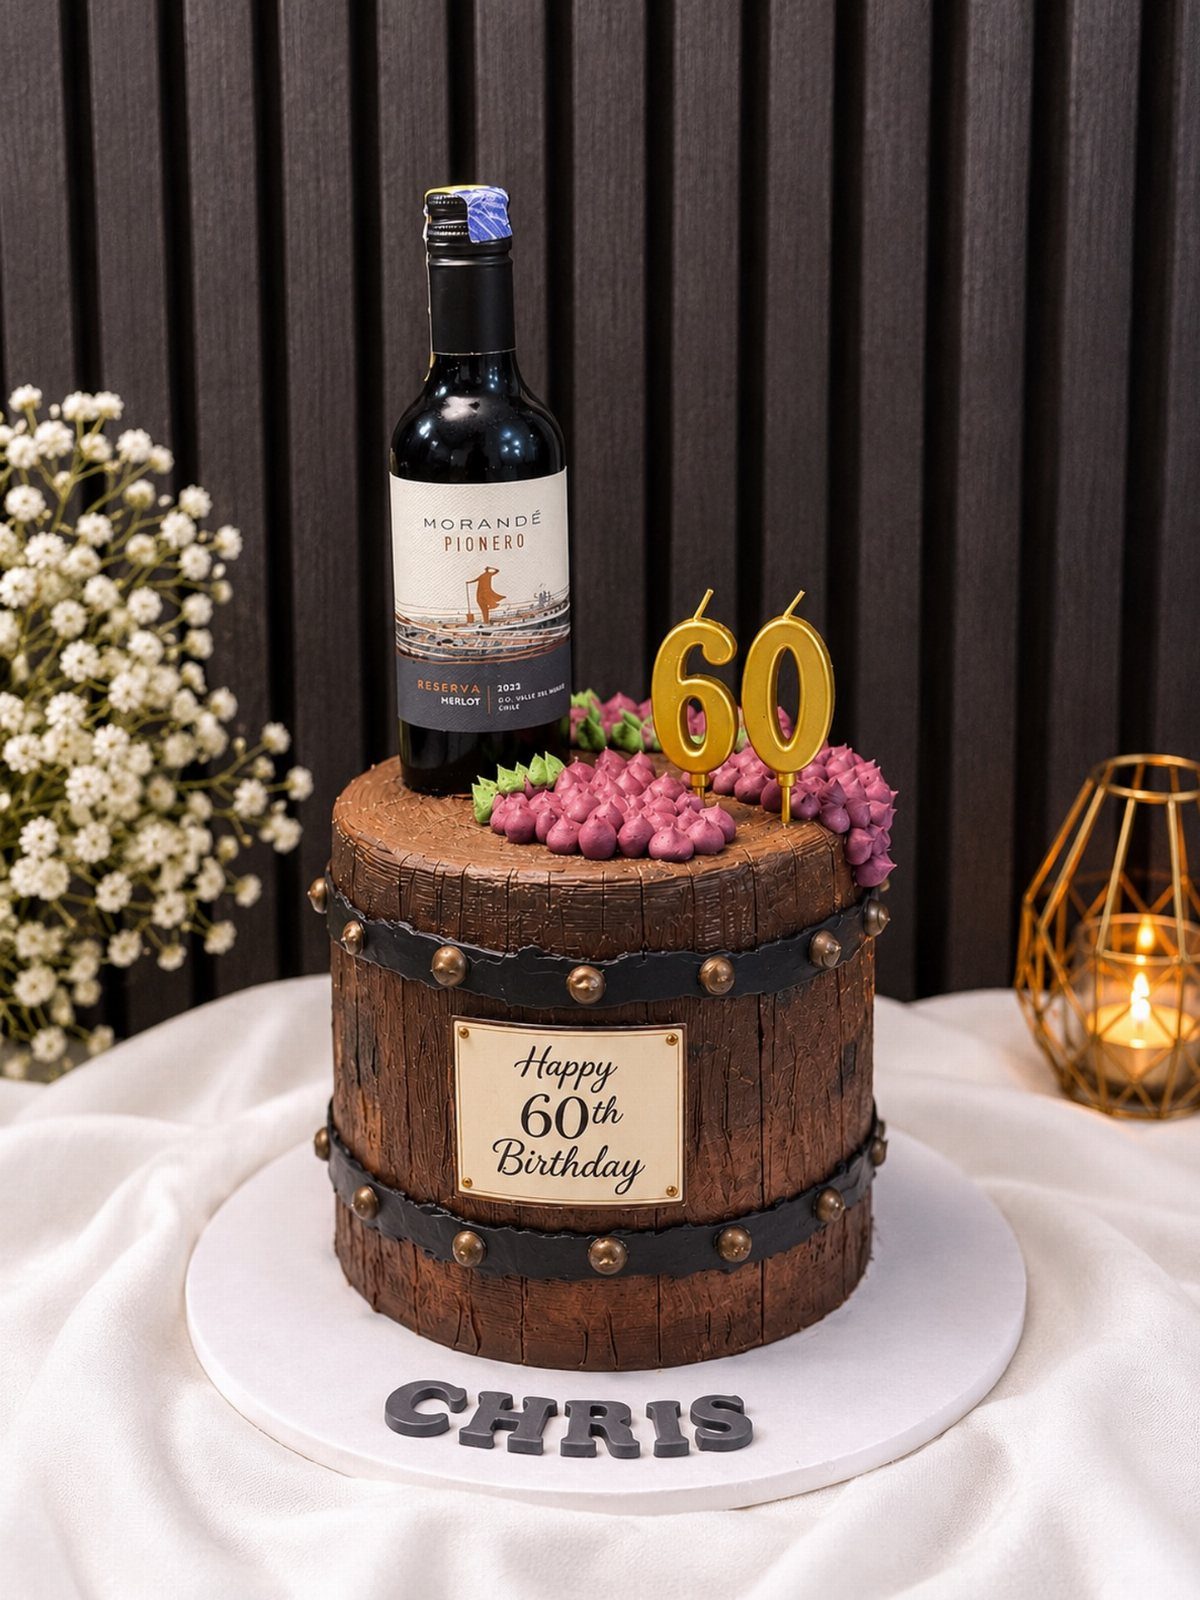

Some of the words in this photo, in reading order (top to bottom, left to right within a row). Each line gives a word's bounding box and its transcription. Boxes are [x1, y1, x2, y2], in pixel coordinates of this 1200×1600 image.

[423, 510, 542, 530] MORANDÉ
[444, 533, 525, 552] PIONERO
[417, 679, 481, 694] RESERVA
[440, 696, 481, 706] MERLOT
[652, 616, 836, 774] 60
[513, 1045, 618, 1094] Happy
[520, 1093, 624, 1139] 60th
[492, 1138, 646, 1195] Birthday
[384, 1379, 754, 1459] CHRIS
